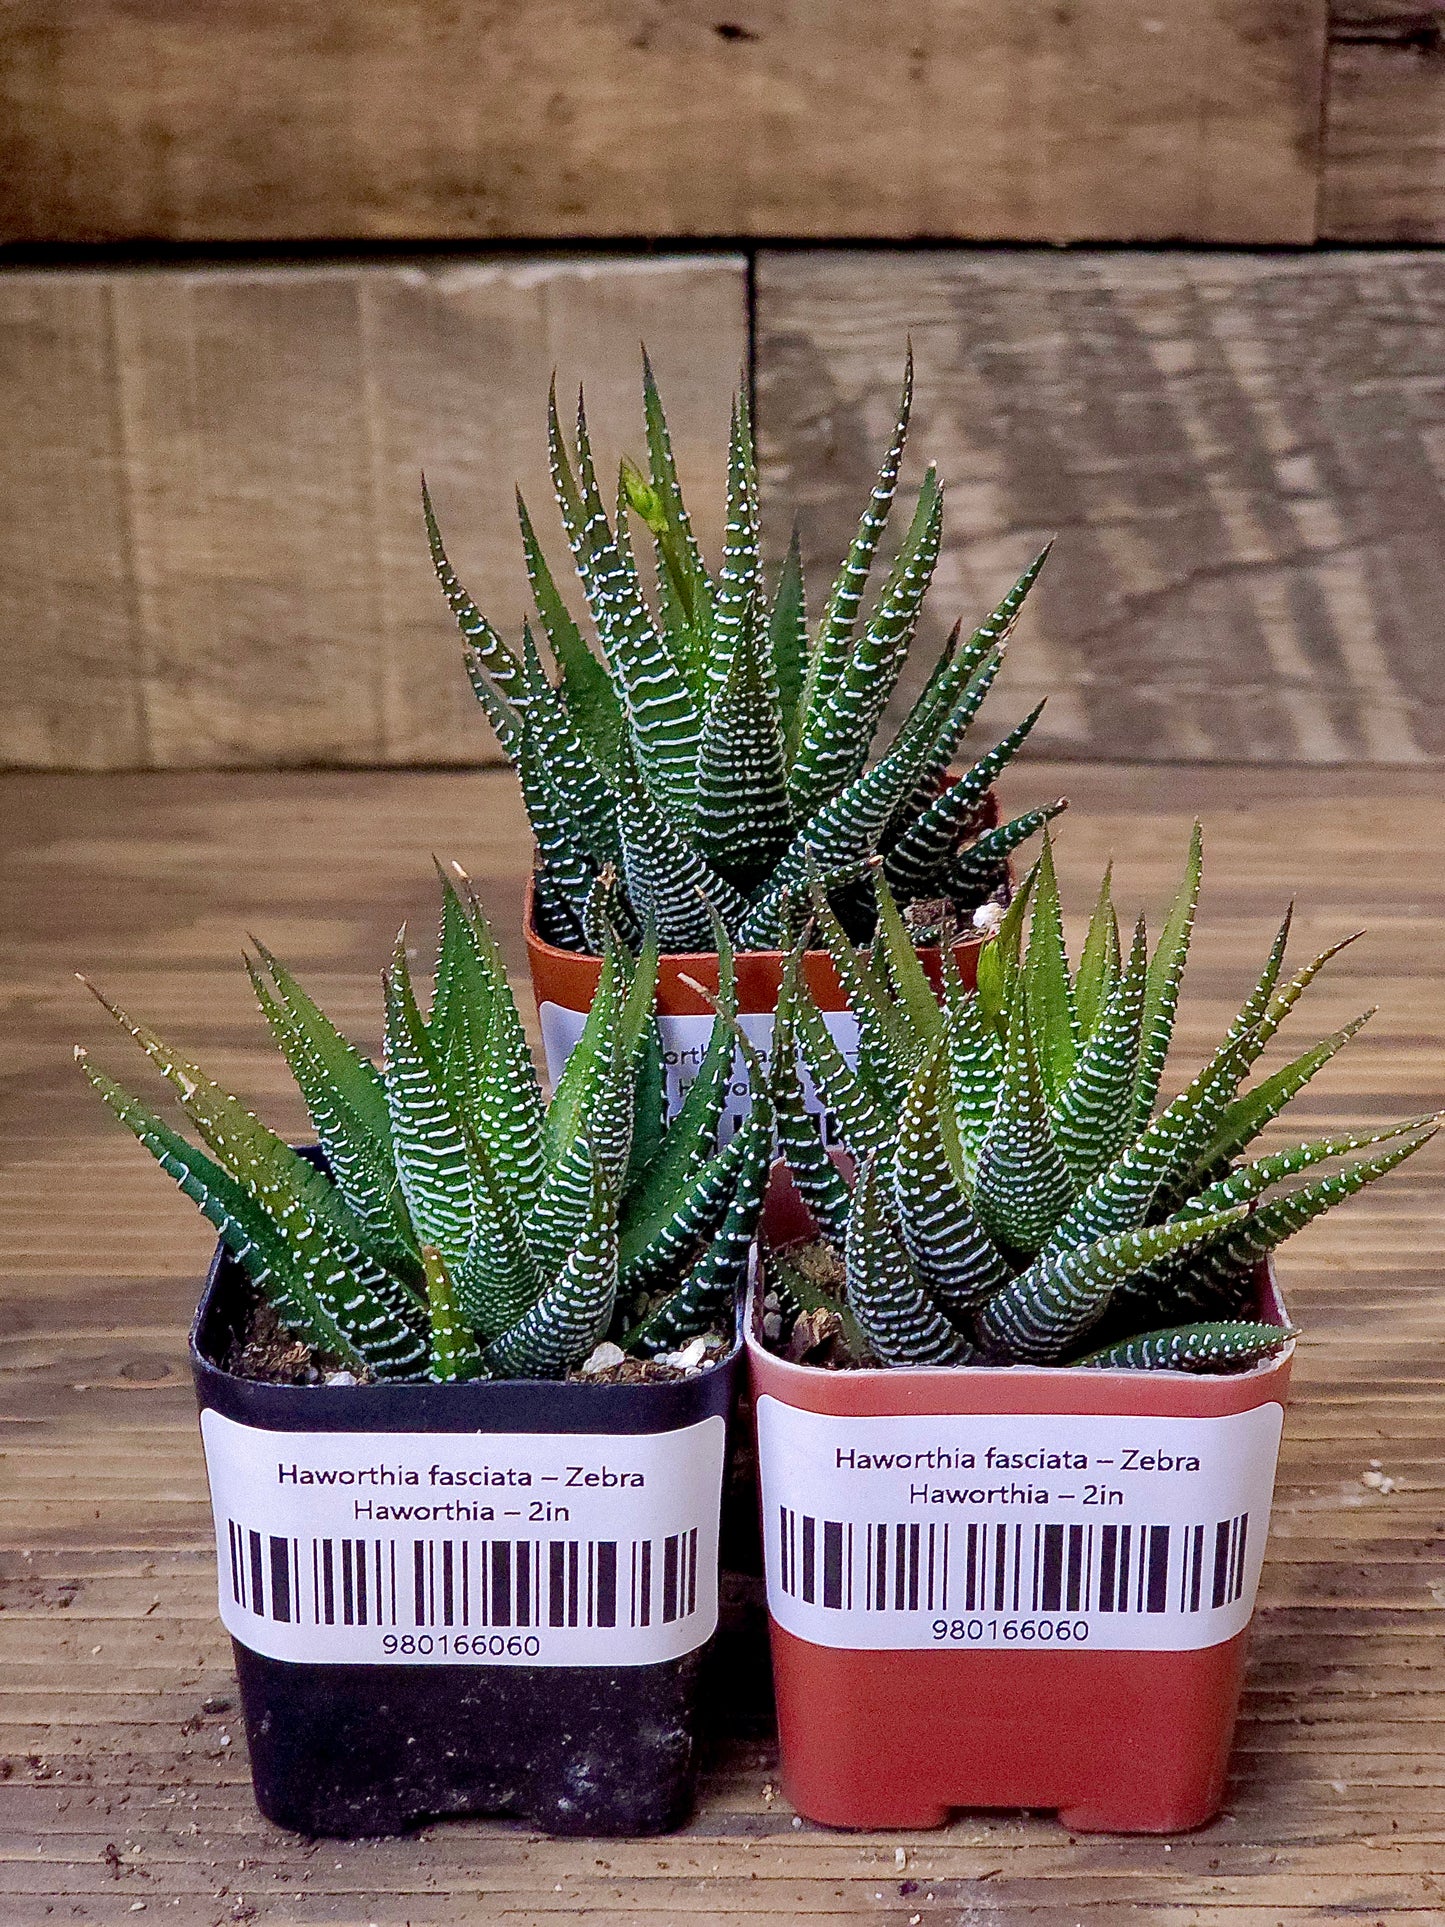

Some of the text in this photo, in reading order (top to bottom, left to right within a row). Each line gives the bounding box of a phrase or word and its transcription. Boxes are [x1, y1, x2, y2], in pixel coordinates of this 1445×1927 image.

[836, 1446, 976, 1470] Haworthia
[984, 1446, 1088, 1470] fasciata
[1119, 1448, 1201, 1472] Zebra
[278, 1463, 419, 1486] Haworthia
[428, 1464, 532, 1487] fasciata
[564, 1465, 645, 1488] Zebra
[910, 1482, 1049, 1505] Haworthia
[1082, 1484, 1124, 1506] 2in
[354, 1499, 495, 1522] Haworthia
[528, 1501, 570, 1522] 2in
[932, 1619, 1089, 1642] 980166060
[382, 1634, 540, 1657] 980166060
